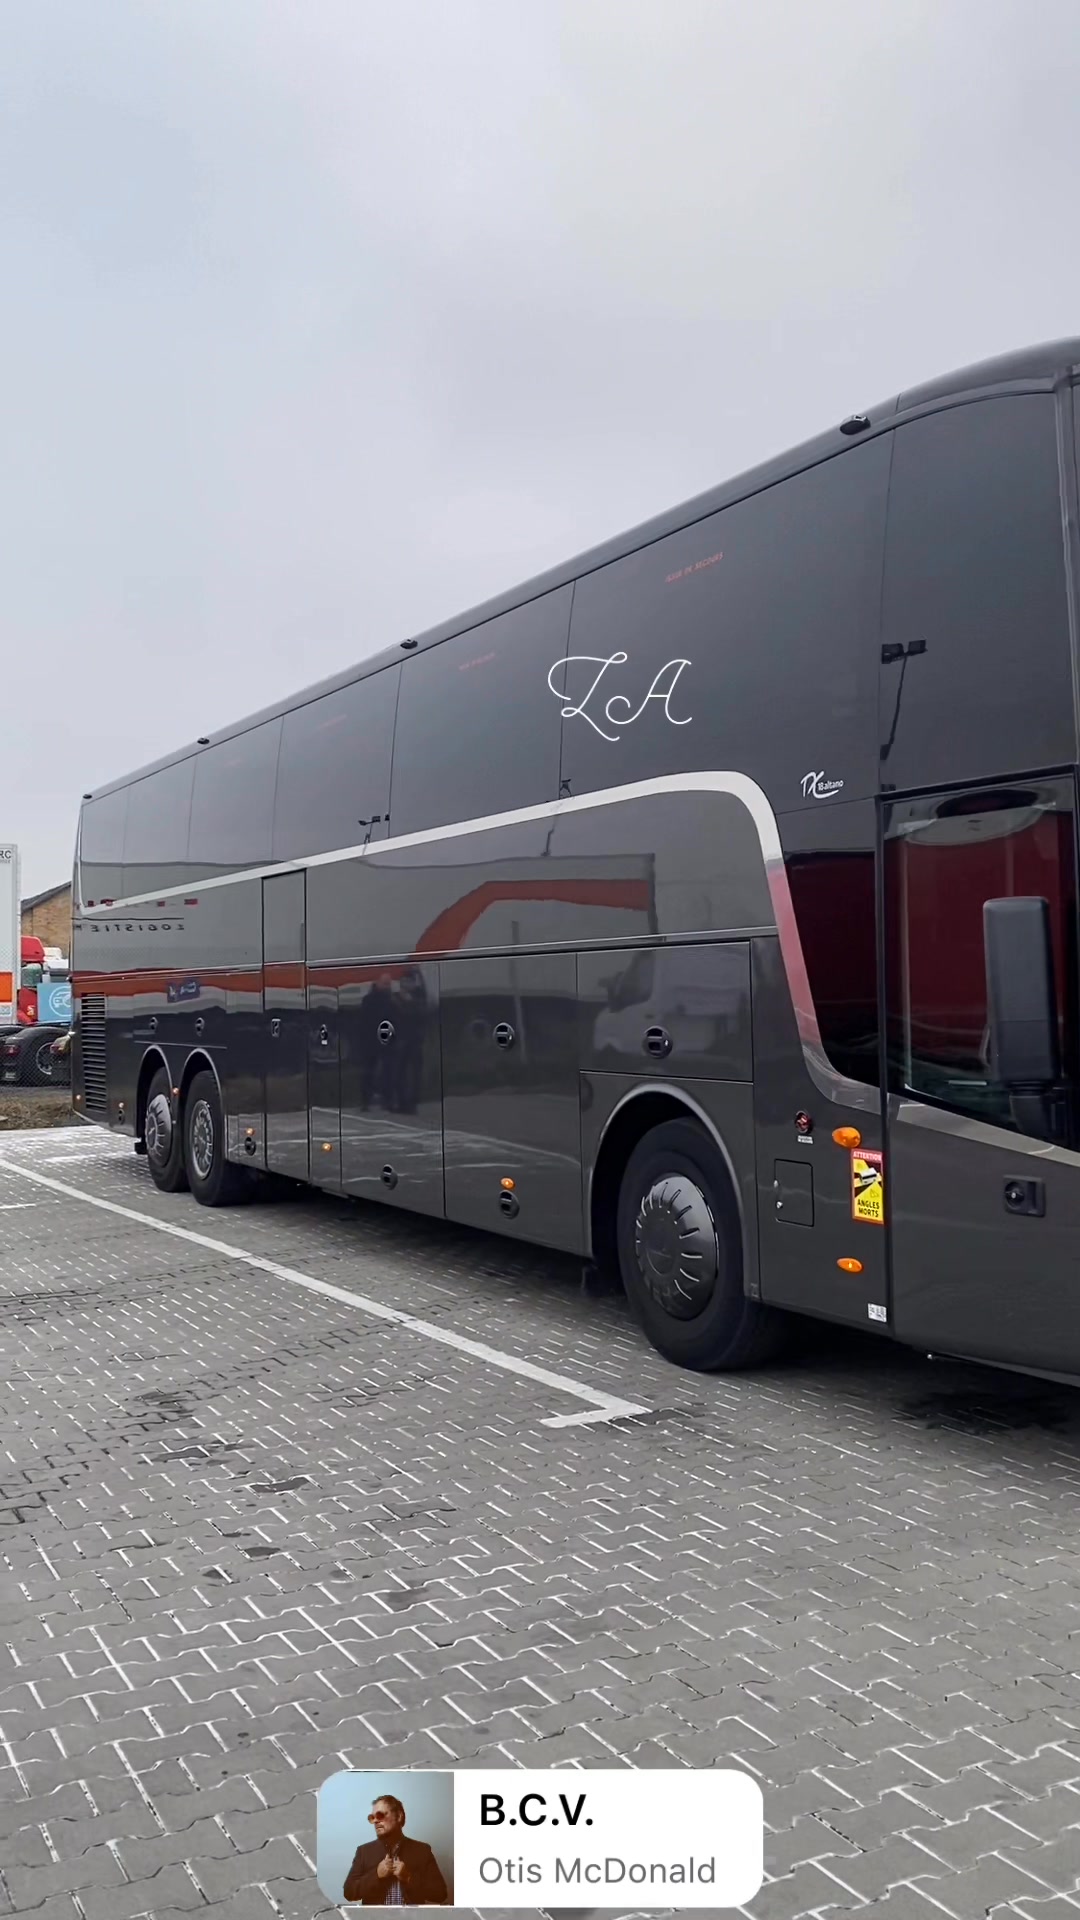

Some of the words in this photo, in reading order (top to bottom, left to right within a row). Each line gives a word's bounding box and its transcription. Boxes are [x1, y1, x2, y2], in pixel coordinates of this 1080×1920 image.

[853, 1150, 882, 1162] ATTENTION
[857, 1198, 880, 1210] ANGLES
[858, 1207, 879, 1218] MORTS
